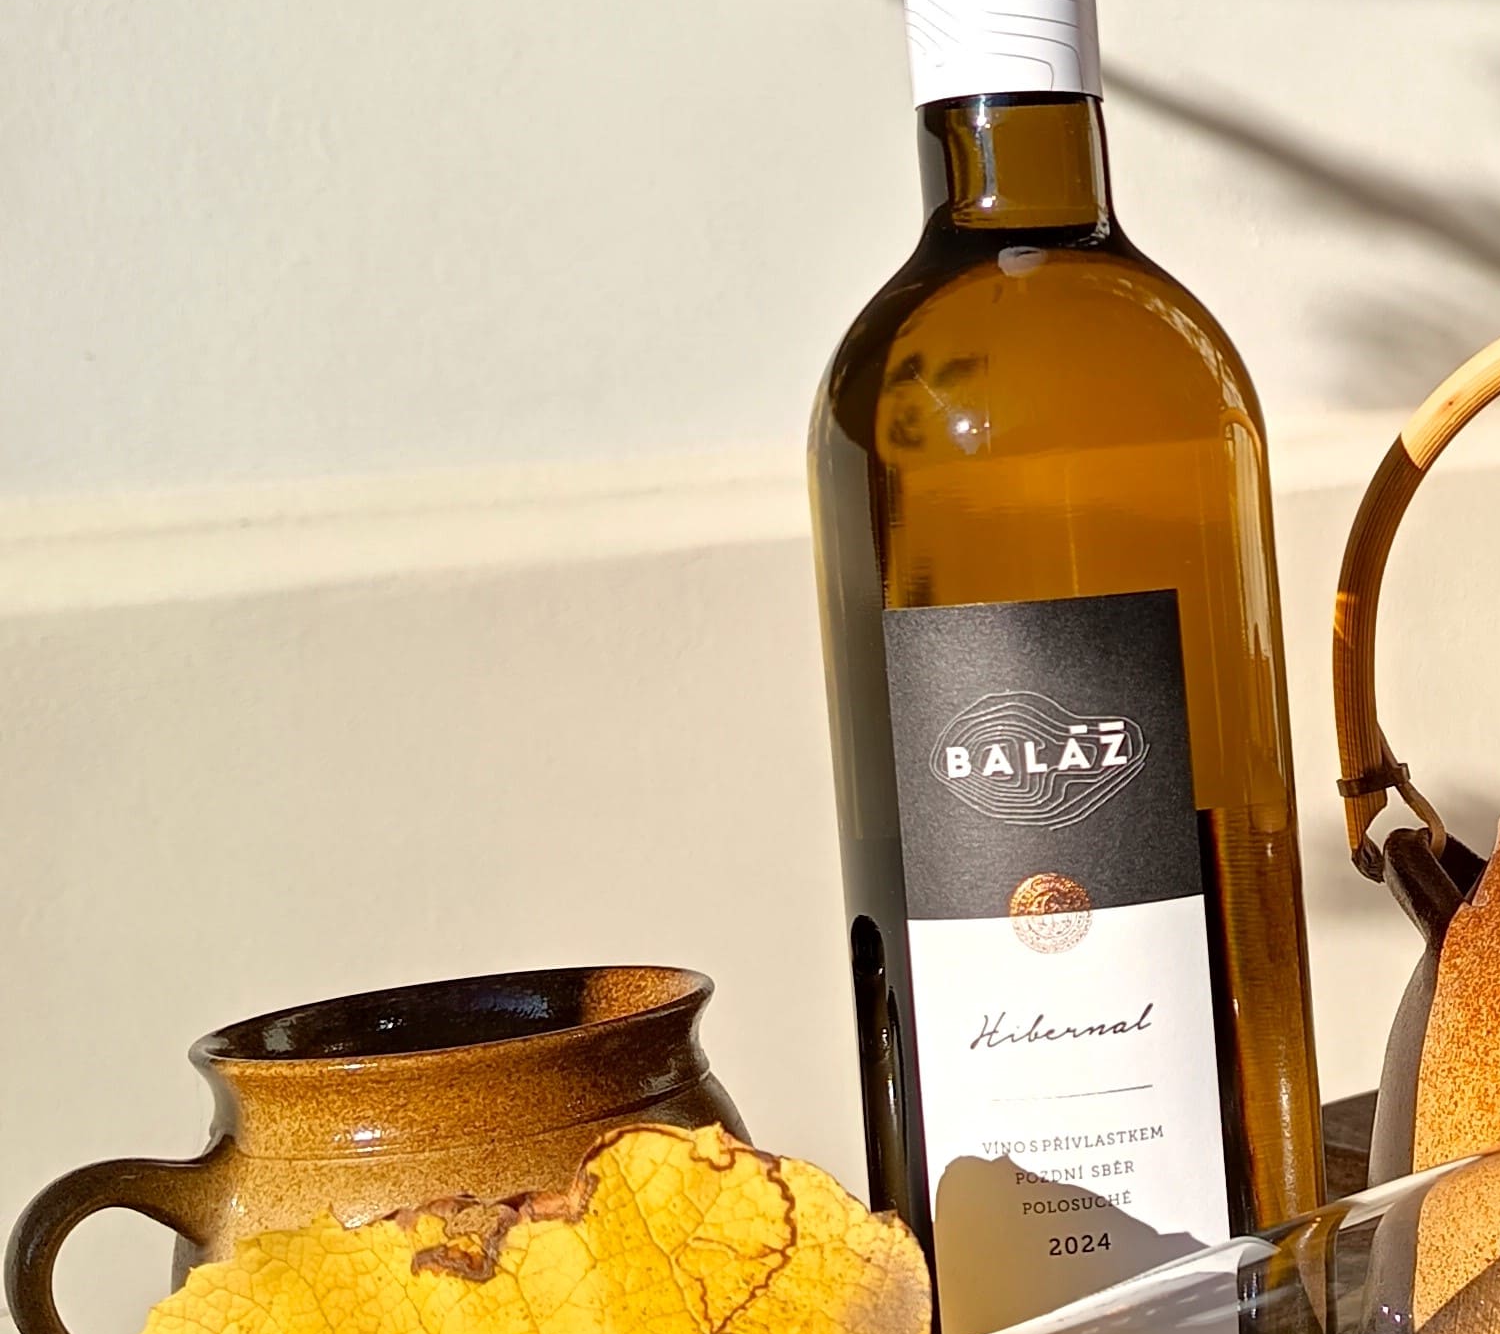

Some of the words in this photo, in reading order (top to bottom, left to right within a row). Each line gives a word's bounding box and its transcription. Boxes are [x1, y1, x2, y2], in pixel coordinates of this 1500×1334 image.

[970, 1003, 1153, 1049] Hibernal
[983, 1141, 1026, 1155] VÍNO
[1042, 1125, 1164, 1153] PŘÍVLASTKEM
[1016, 1165, 1083, 1185] POZDNÍ
[1091, 1160, 1135, 1178] SBĚR
[1022, 1190, 1132, 1215] POLOSUCHÉ
[1049, 1232, 1112, 1256] 2024
